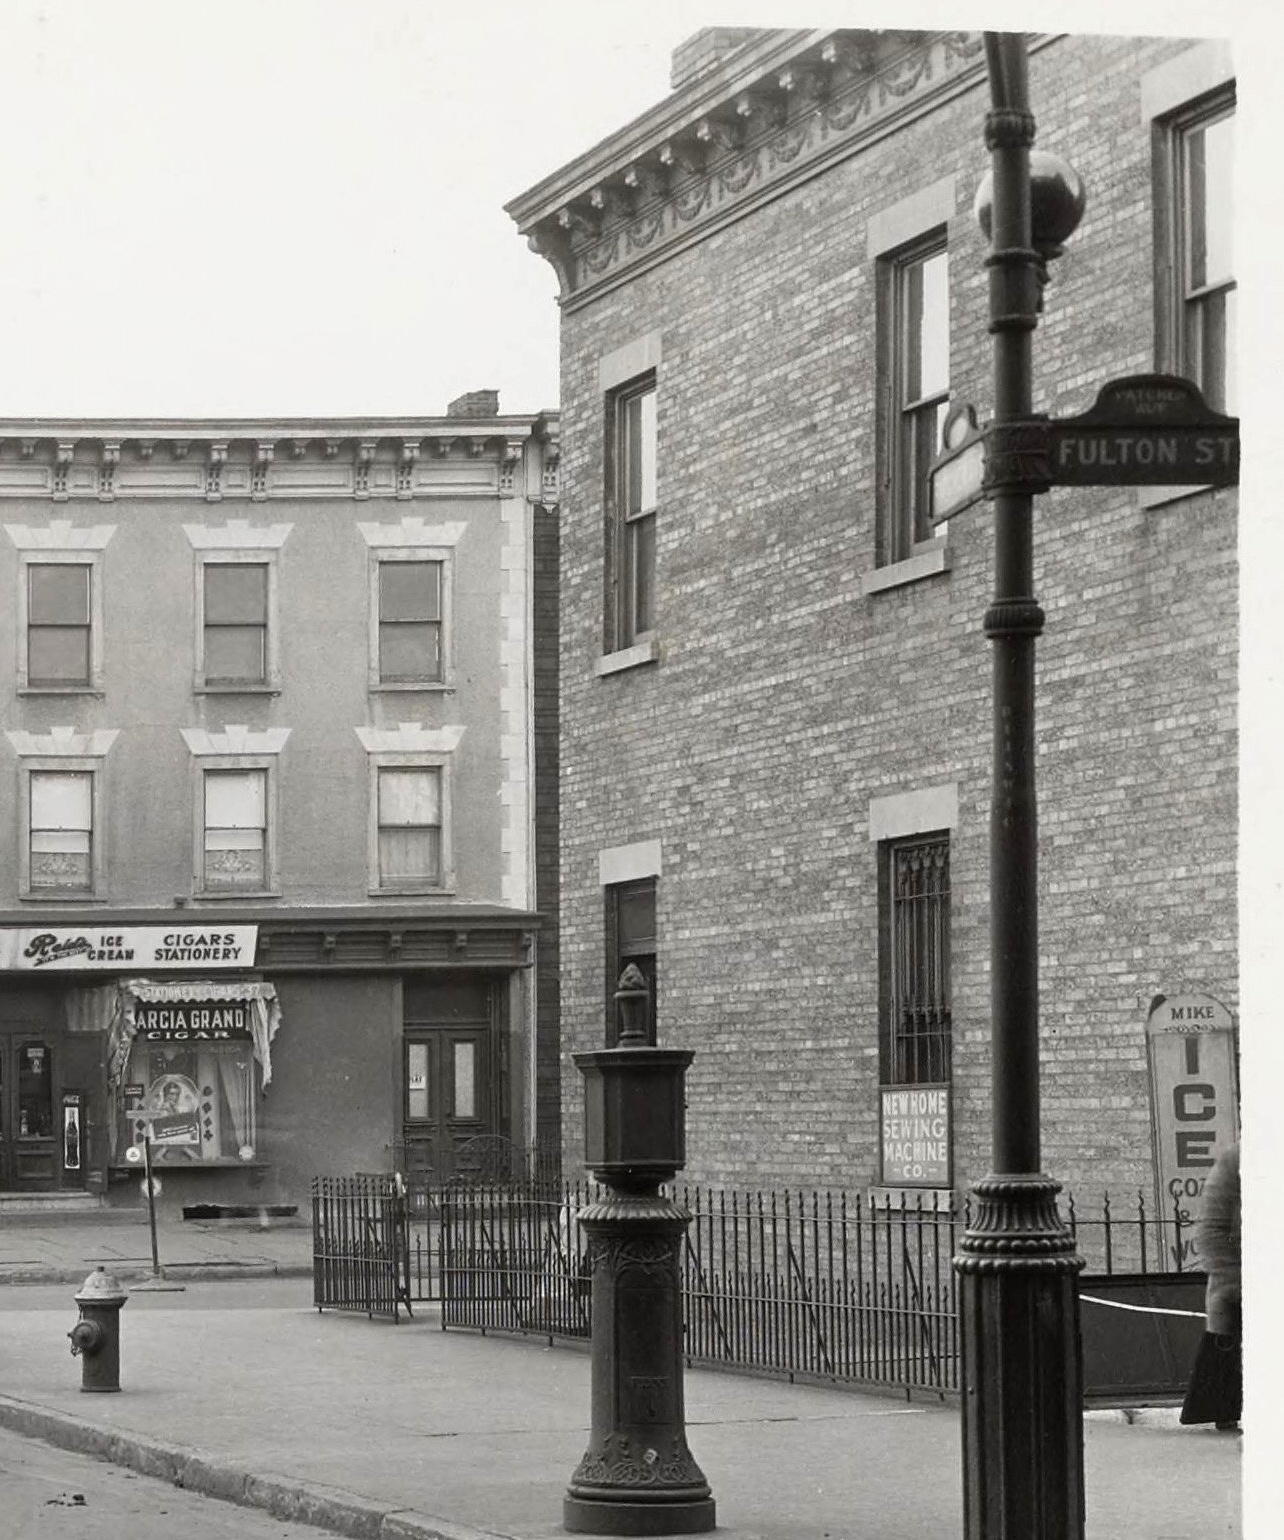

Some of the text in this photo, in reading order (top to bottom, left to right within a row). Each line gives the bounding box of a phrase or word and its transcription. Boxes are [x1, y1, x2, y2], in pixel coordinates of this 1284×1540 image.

[1058, 437, 1236, 466] FULTON ST
[100, 935, 124, 947] ICE
[163, 933, 235, 947] CIGARS
[154, 948, 242, 961] STATIONERY
[135, 1009, 244, 1029] ARCIA GRAND
[1171, 1006, 1214, 1019] MIKE
[147, 1031, 230, 1039] CIGAR
[883, 1092, 947, 1116] NEW HOME
[1172, 1037, 1217, 1169] ICE
[883, 1118, 946, 1139] SEWING
[883, 1142, 947, 1162] MACHINE
